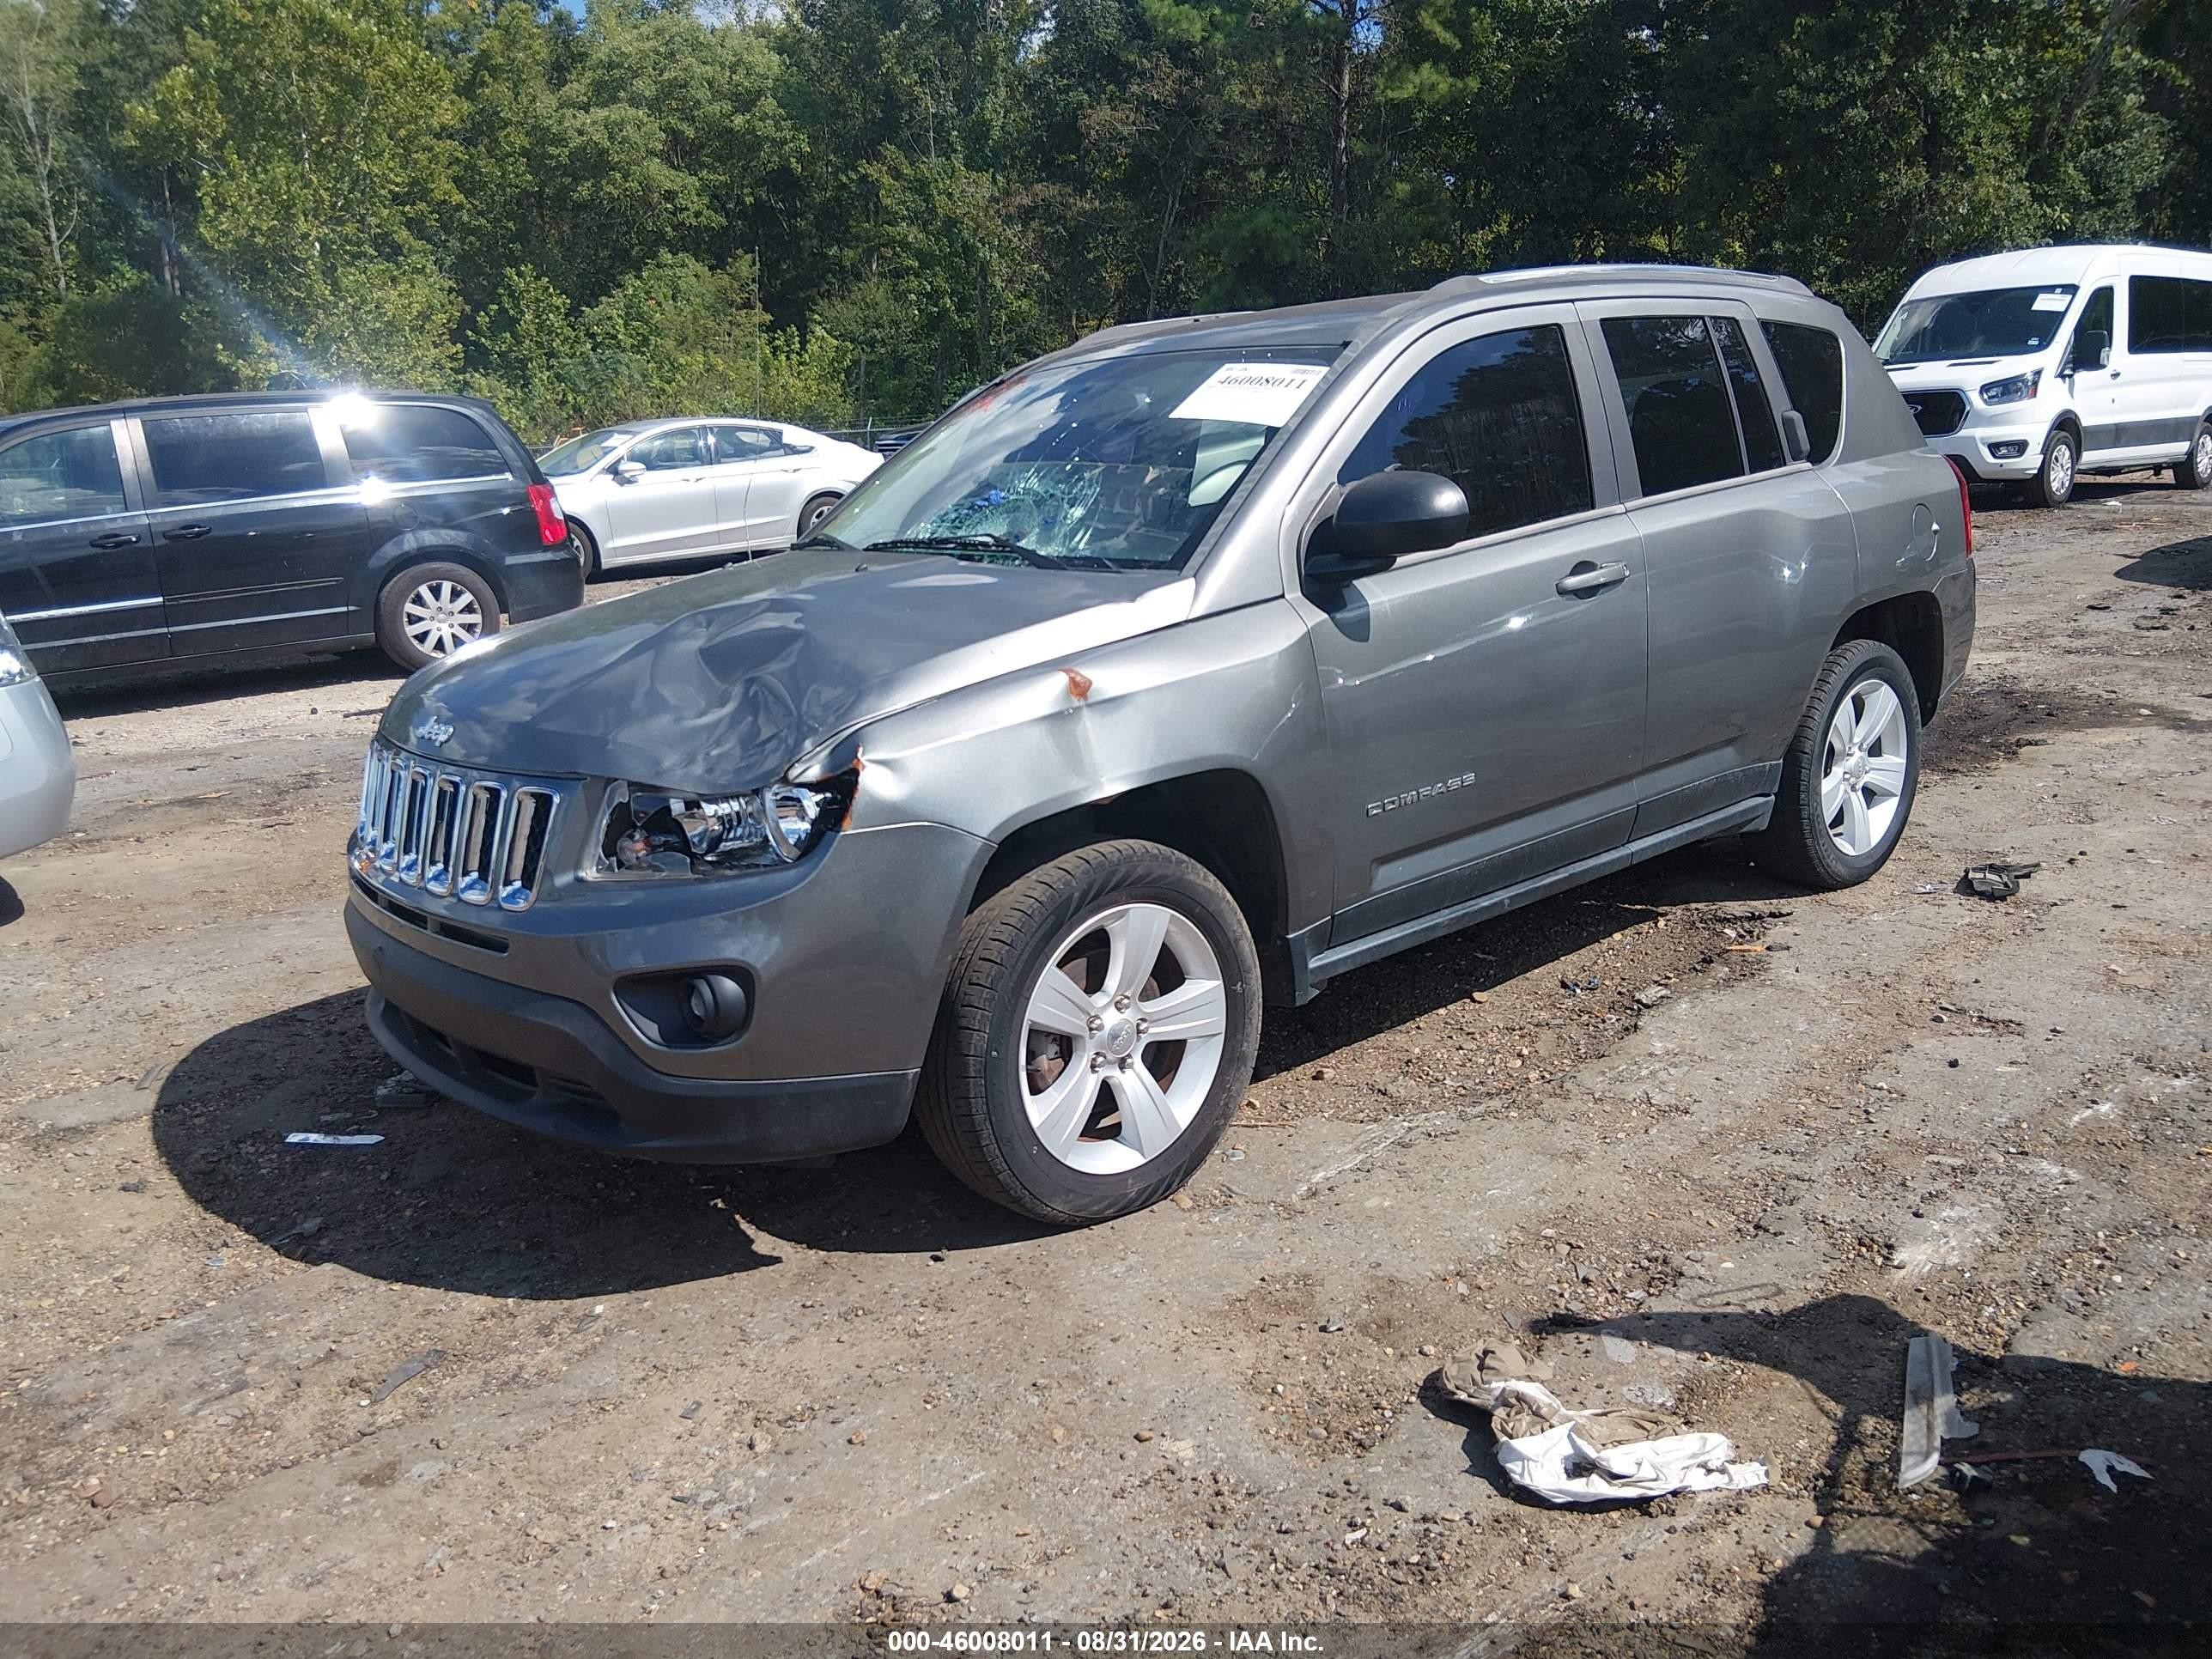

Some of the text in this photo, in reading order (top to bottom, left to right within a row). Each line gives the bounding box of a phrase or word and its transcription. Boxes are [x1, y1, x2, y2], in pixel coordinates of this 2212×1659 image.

[1218, 375, 1308, 389] 46008011
[415, 715, 454, 746] Jeep
[1367, 772, 1476, 816] COMPASS
